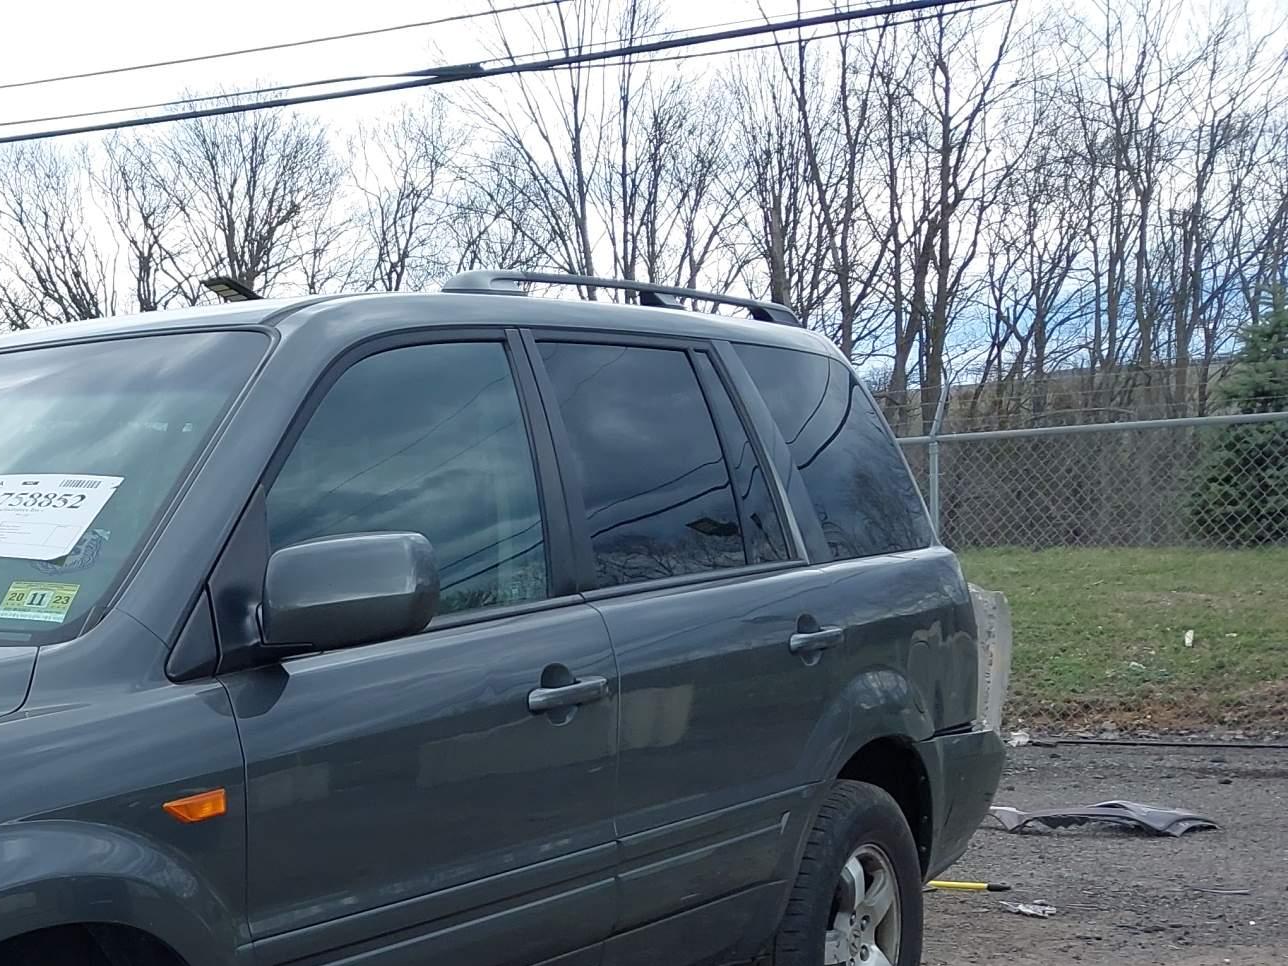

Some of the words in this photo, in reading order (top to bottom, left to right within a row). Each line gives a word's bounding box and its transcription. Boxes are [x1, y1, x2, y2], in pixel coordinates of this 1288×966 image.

[7, 592, 25, 602] 20
[26, 592, 48, 606] 11
[53, 595, 71, 605] 23
